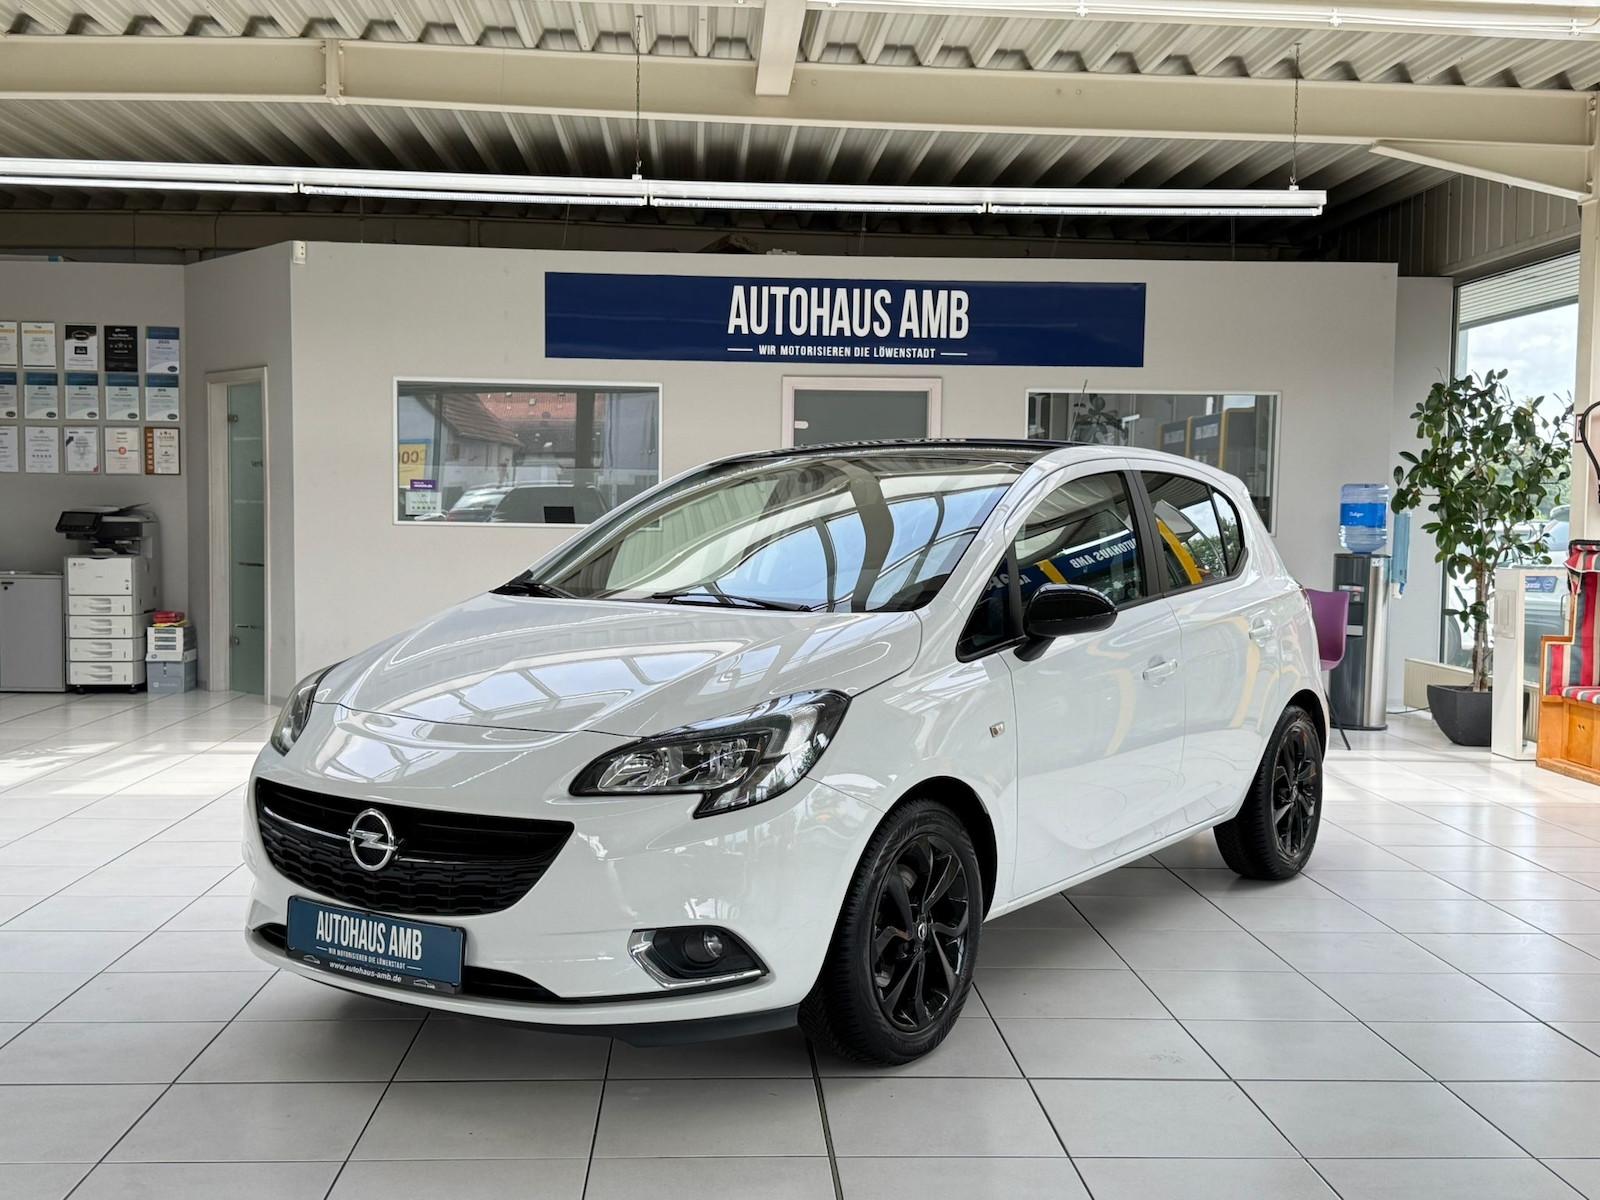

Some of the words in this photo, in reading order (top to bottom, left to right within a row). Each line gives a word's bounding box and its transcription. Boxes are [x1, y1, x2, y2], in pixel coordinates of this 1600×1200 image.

[727, 285, 892, 338] AUTOHAUS
[899, 289, 969, 339] AMB
[758, 344, 777, 355] WIR
[780, 345, 851, 357] MOTORISIEREN
[854, 346, 870, 358] DIE
[873, 346, 936, 359] LÖWENSTADT
[316, 910, 386, 954] AUTOHAUS
[389, 925, 423, 961] AMB
[329, 961, 402, 983] www.autohaus-amb.de
